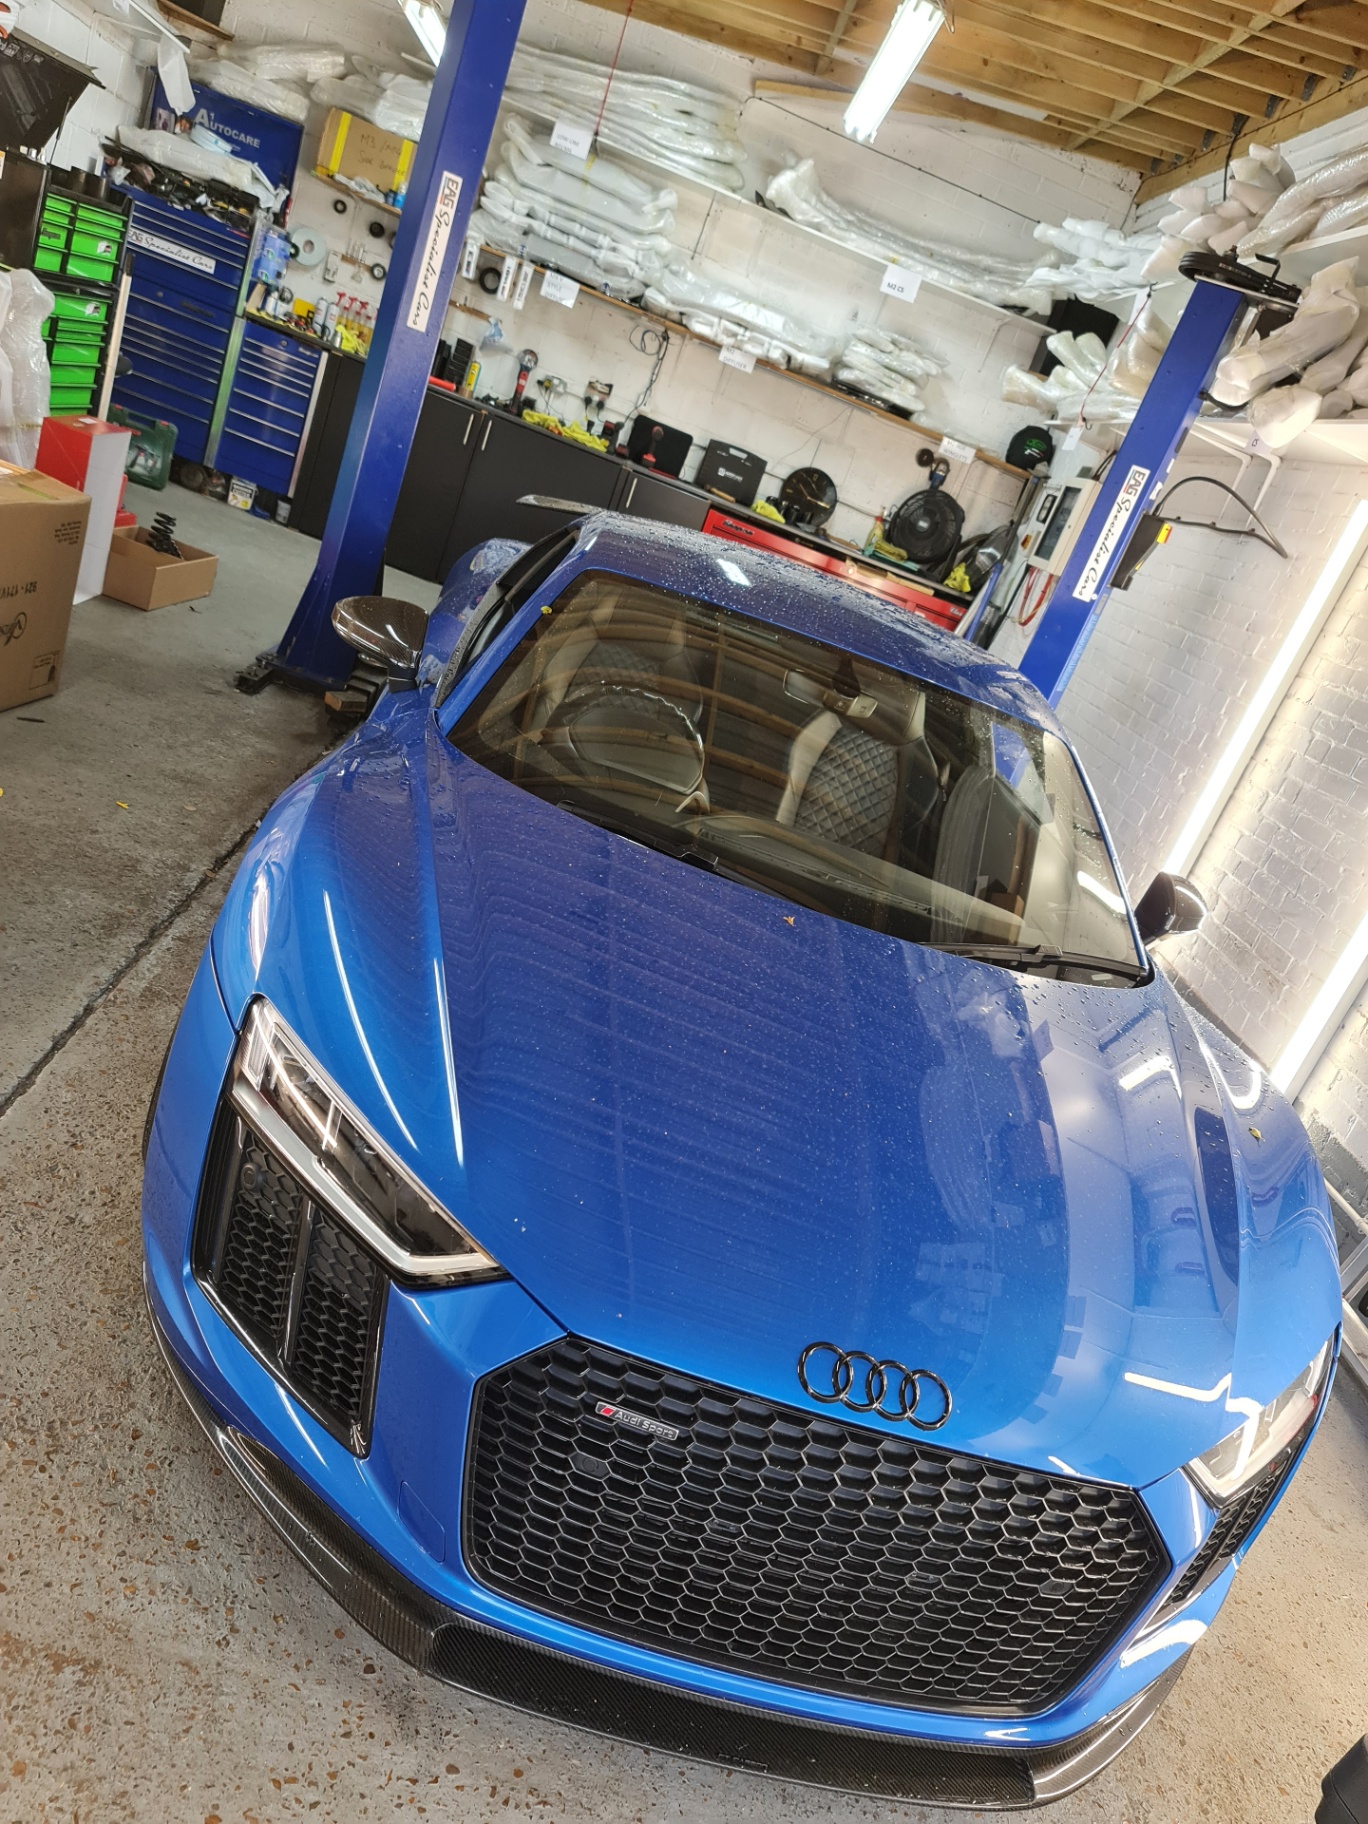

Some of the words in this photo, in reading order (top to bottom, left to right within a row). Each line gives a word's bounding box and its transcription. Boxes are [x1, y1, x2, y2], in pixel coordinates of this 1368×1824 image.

[441, 177, 459, 209] EAG
[424, 208, 450, 289] Specialist
[412, 291, 429, 326] Cars
[1126, 470, 1146, 497] EAG
[1093, 498, 1132, 565] Specialist
[1078, 567, 1098, 597] Cars
[615, 1411, 640, 1426] Audi
[641, 1420, 675, 1438] Sport
